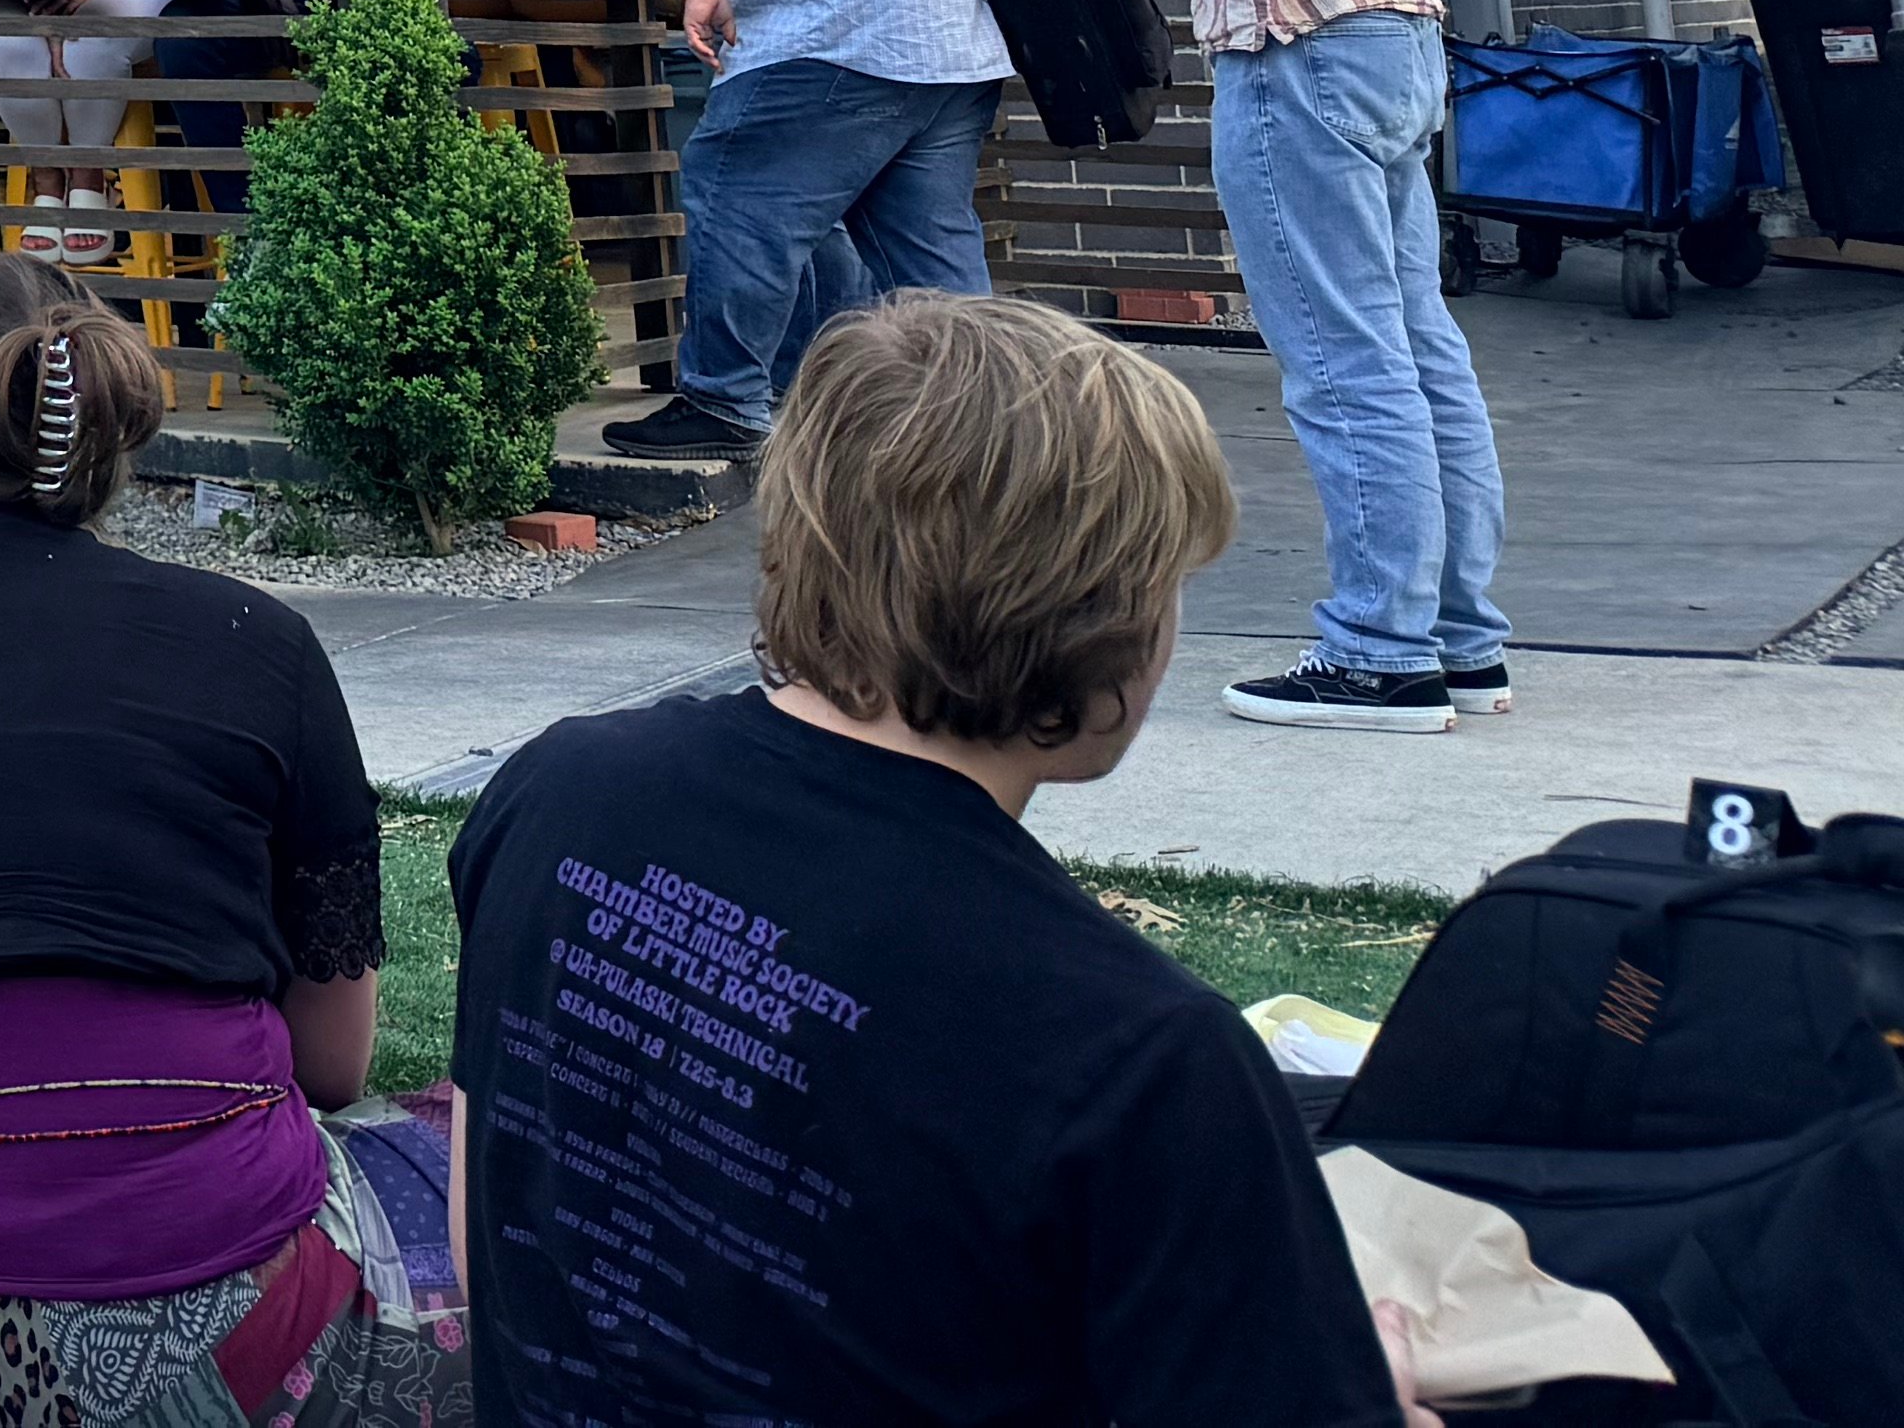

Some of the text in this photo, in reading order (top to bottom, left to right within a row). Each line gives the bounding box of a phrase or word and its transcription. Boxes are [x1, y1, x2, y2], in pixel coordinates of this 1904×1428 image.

[1708, 794, 1754, 856] 8
[557, 856, 871, 1031] CHAMBER MUSIC SOCIETY
[641, 863, 789, 951] HOSTED BY
[550, 938, 809, 1093] @ UA-PULASKI TECHNICAL
[587, 908, 798, 1033] OF LITTLE ROCK
[556, 989, 642, 1044] SEASON
[641, 1032, 668, 1059] 18
[551, 1062, 608, 1103] CONCERT
[576, 1045, 636, 1084] CONCERT
[698, 1114, 789, 1172] MASTERCLASS
